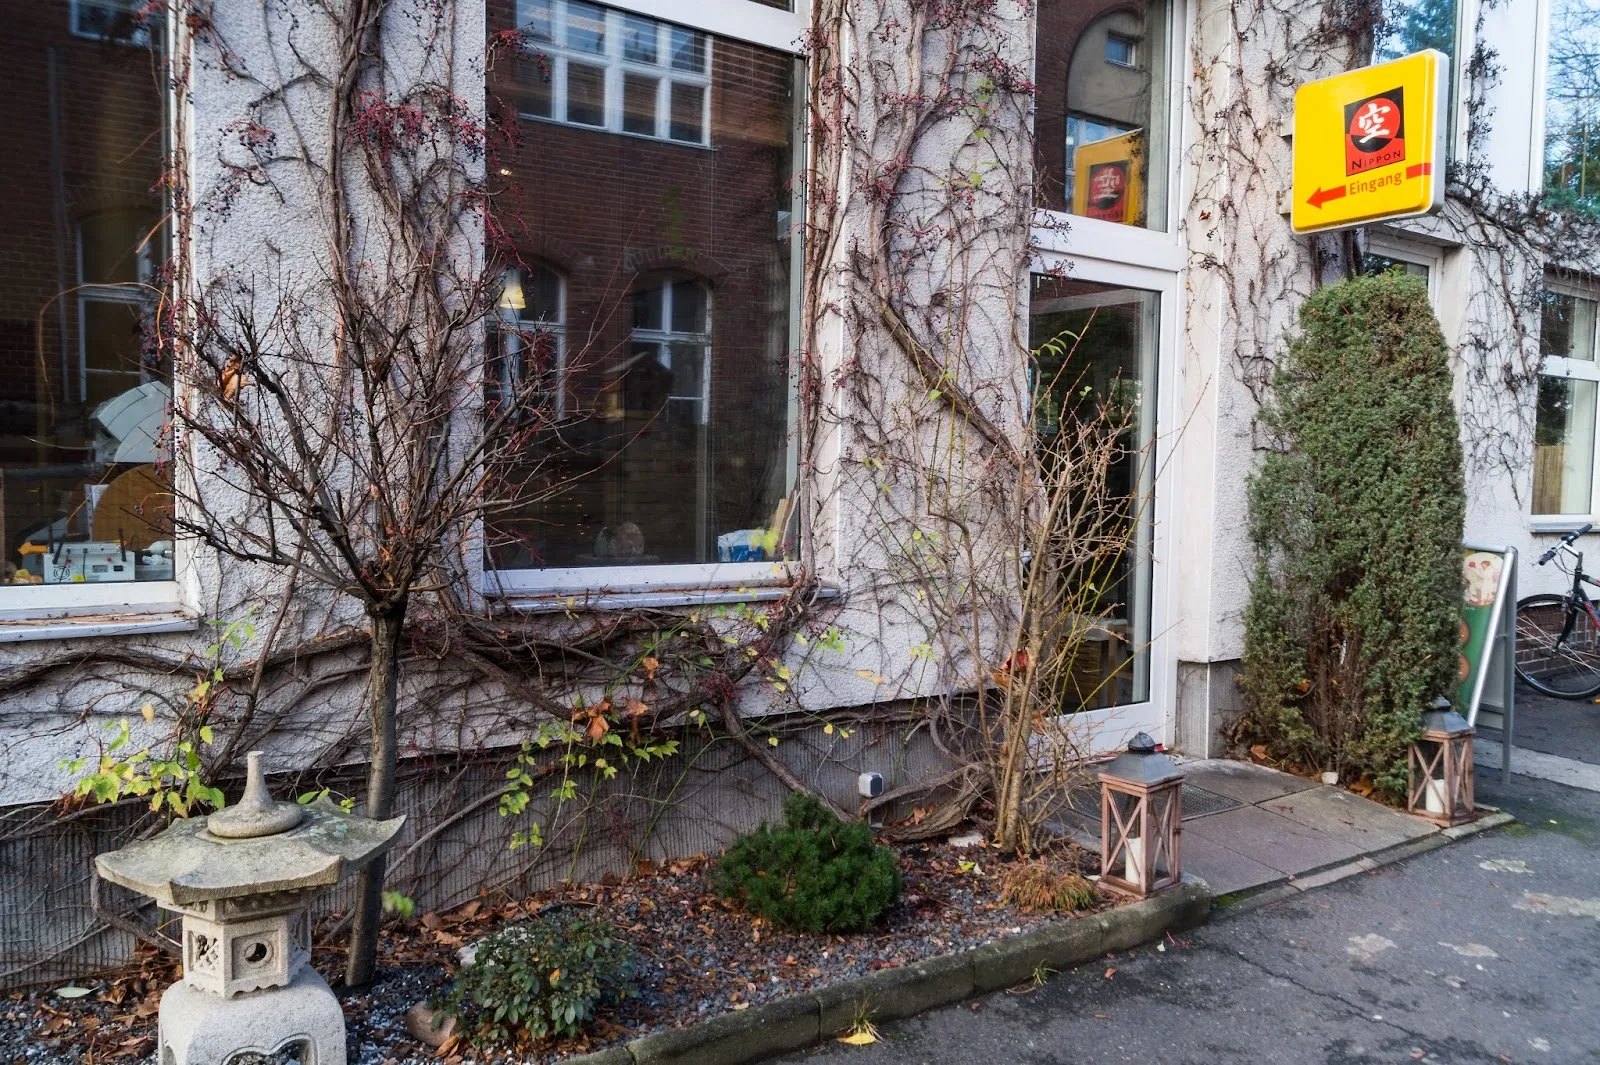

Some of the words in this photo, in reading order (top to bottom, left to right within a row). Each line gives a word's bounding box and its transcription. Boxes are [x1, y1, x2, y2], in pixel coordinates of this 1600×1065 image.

[1358, 103, 1391, 144] 空
[1351, 150, 1401, 170] NIPPON
[1350, 172, 1402, 195] Eingang
